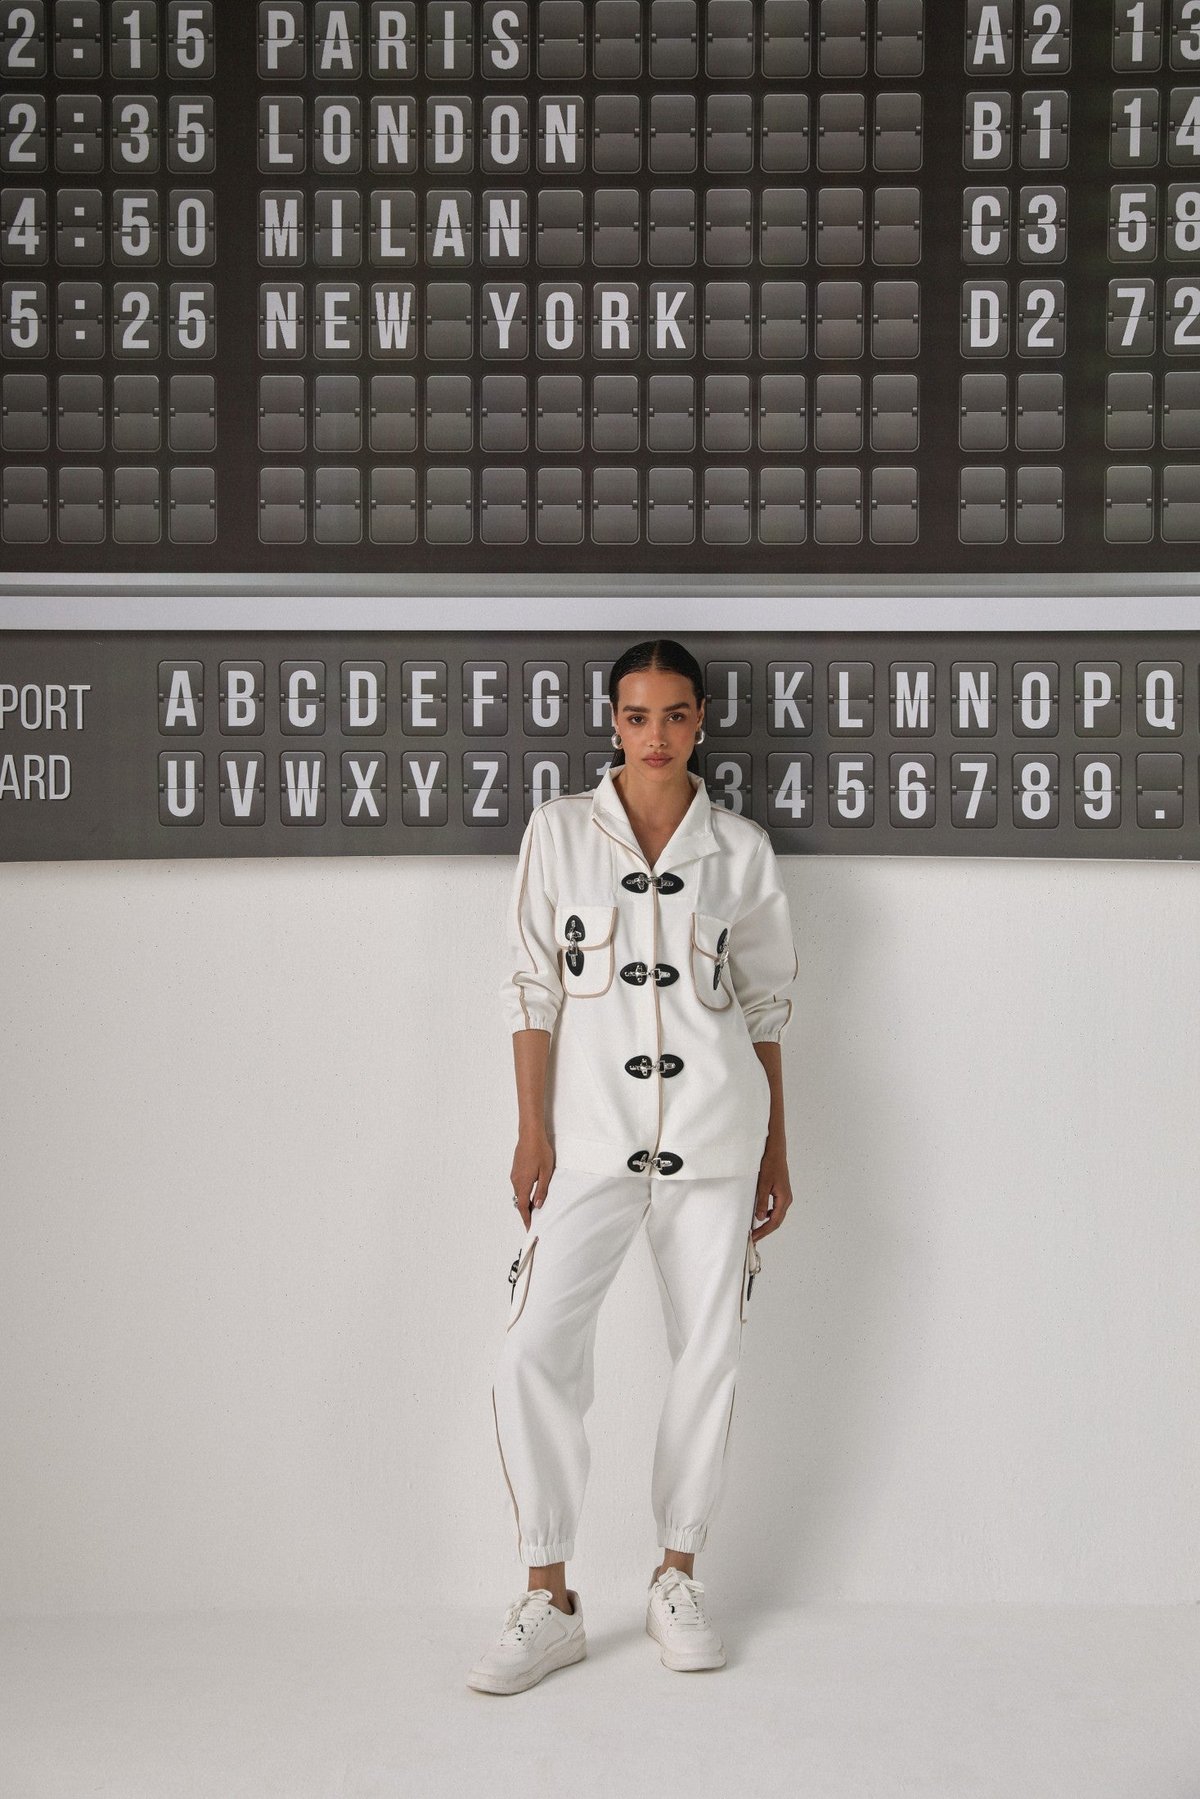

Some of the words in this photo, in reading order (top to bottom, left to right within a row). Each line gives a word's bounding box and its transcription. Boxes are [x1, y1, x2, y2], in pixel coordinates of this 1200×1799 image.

[8, 9, 205, 69] 2:15
[267, 10, 520, 70] PARIS
[972, 5, 1061, 65] A2
[9, 103, 205, 163] 2:35
[268, 104, 577, 165] LONDON
[973, 99, 1051, 160] B1
[8, 197, 206, 257] 4:50
[264, 199, 520, 258] MILAN
[971, 194, 1058, 256] C3
[1117, 191, 1200, 252] 58
[10, 290, 206, 349] 5:25
[265, 291, 412, 350] NEW
[488, 291, 687, 350] YORK
[970, 288, 1056, 348] D2
[1116, 286, 1200, 346] 72
